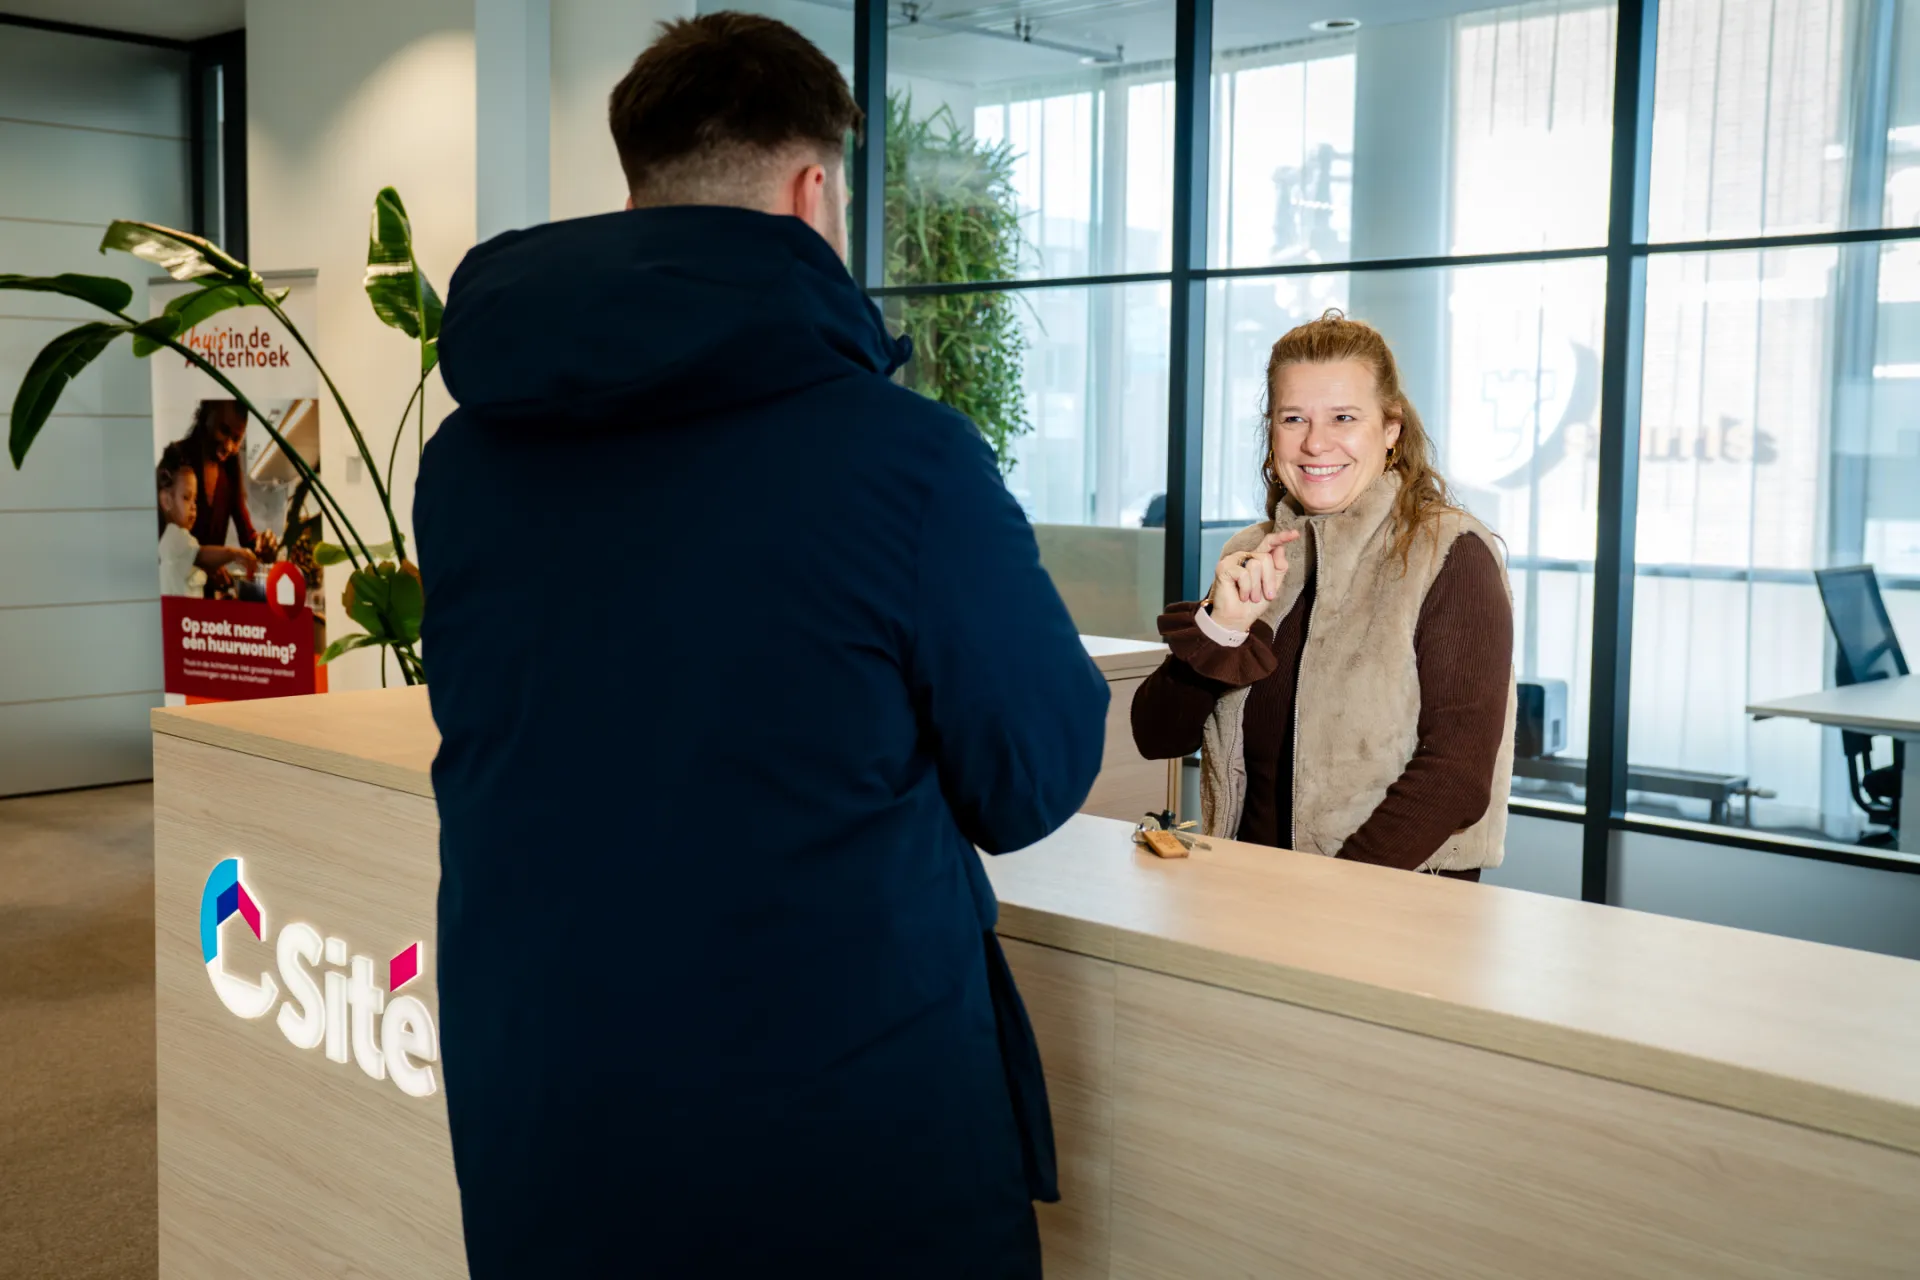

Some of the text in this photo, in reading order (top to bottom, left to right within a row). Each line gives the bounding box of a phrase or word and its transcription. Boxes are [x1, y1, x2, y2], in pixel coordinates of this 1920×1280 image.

[229, 327, 243, 348] in
[249, 326, 270, 348] de
[181, 617, 267, 640] Op zoek naar
[207, 636, 297, 665] huurwoning?
